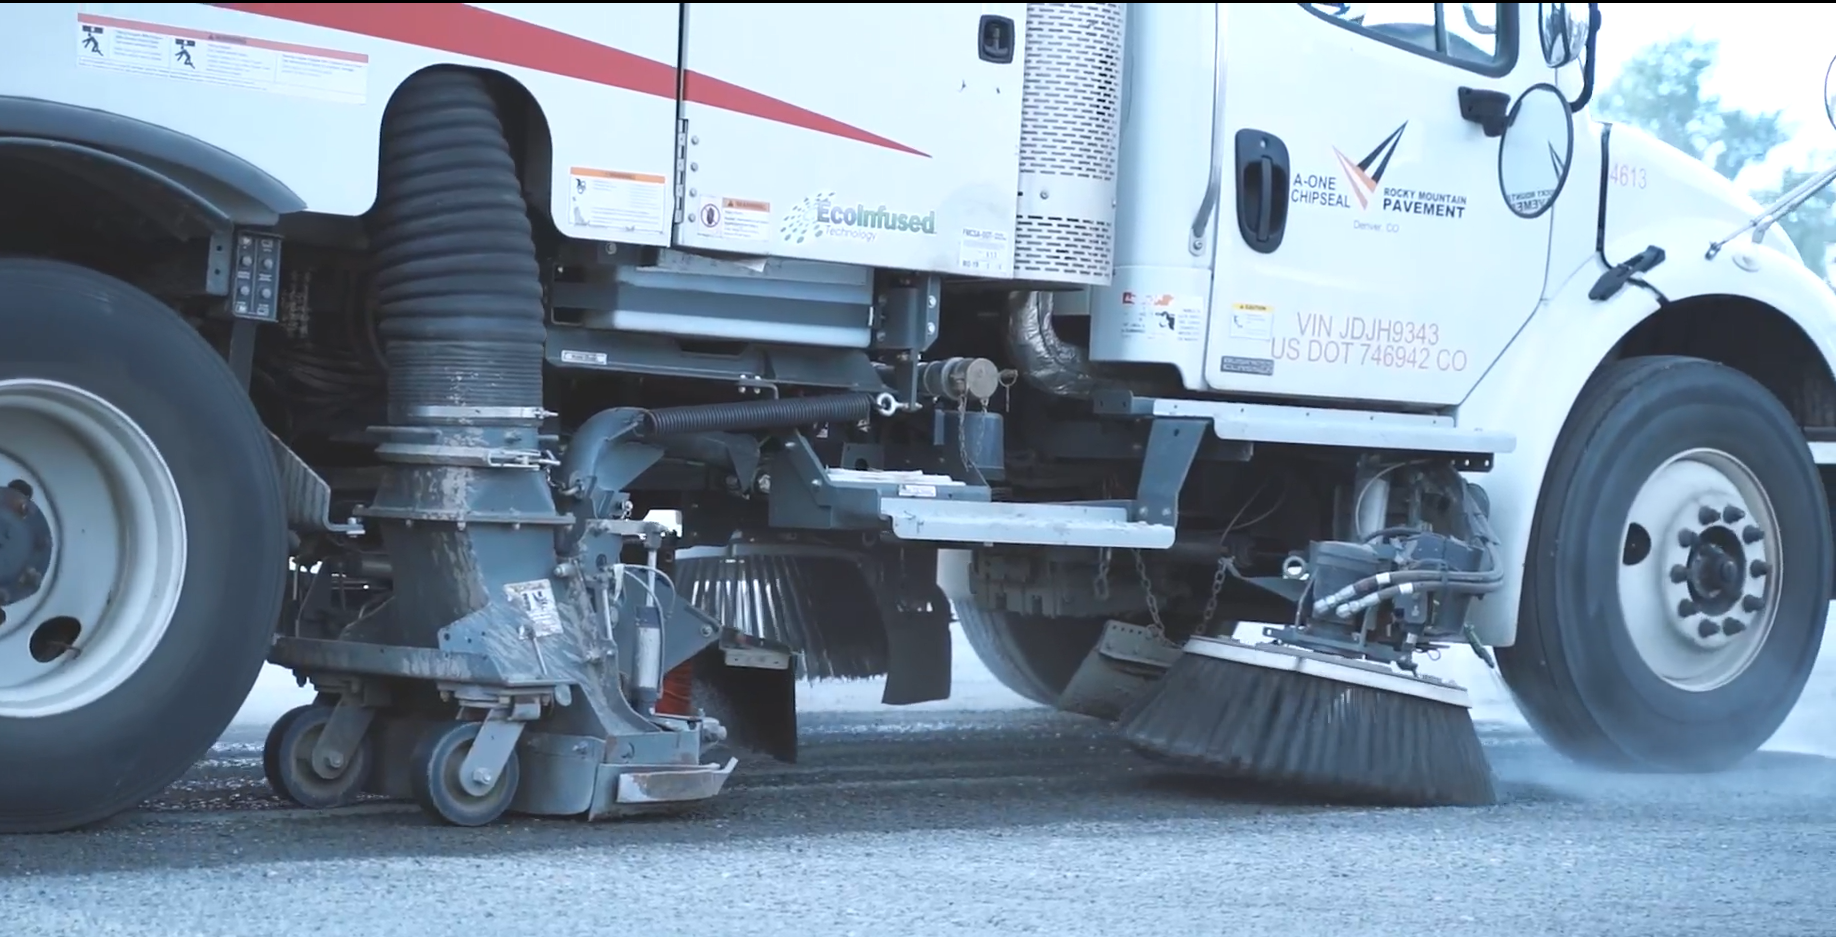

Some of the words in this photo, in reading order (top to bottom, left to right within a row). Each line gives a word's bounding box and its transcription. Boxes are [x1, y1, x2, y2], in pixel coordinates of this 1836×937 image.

[1293, 173, 1337, 191] A-ONE
[1291, 189, 1351, 209] CHIPSEAL
[1384, 187, 1416, 199] ROCKY
[1418, 191, 1467, 205] MOUNTAIN
[816, 199, 935, 235] EcoInfused
[1383, 198, 1466, 219] PAVEMENT
[825, 224, 878, 242] Technology
[1386, 222, 1400, 233] CO
[1297, 312, 1333, 338] VIN
[1339, 316, 1440, 346] JDJH9343
[1271, 337, 1301, 360] US
[1307, 340, 1353, 364] DOT
[1360, 343, 1431, 370] 746942
[1437, 349, 1468, 372] CO
